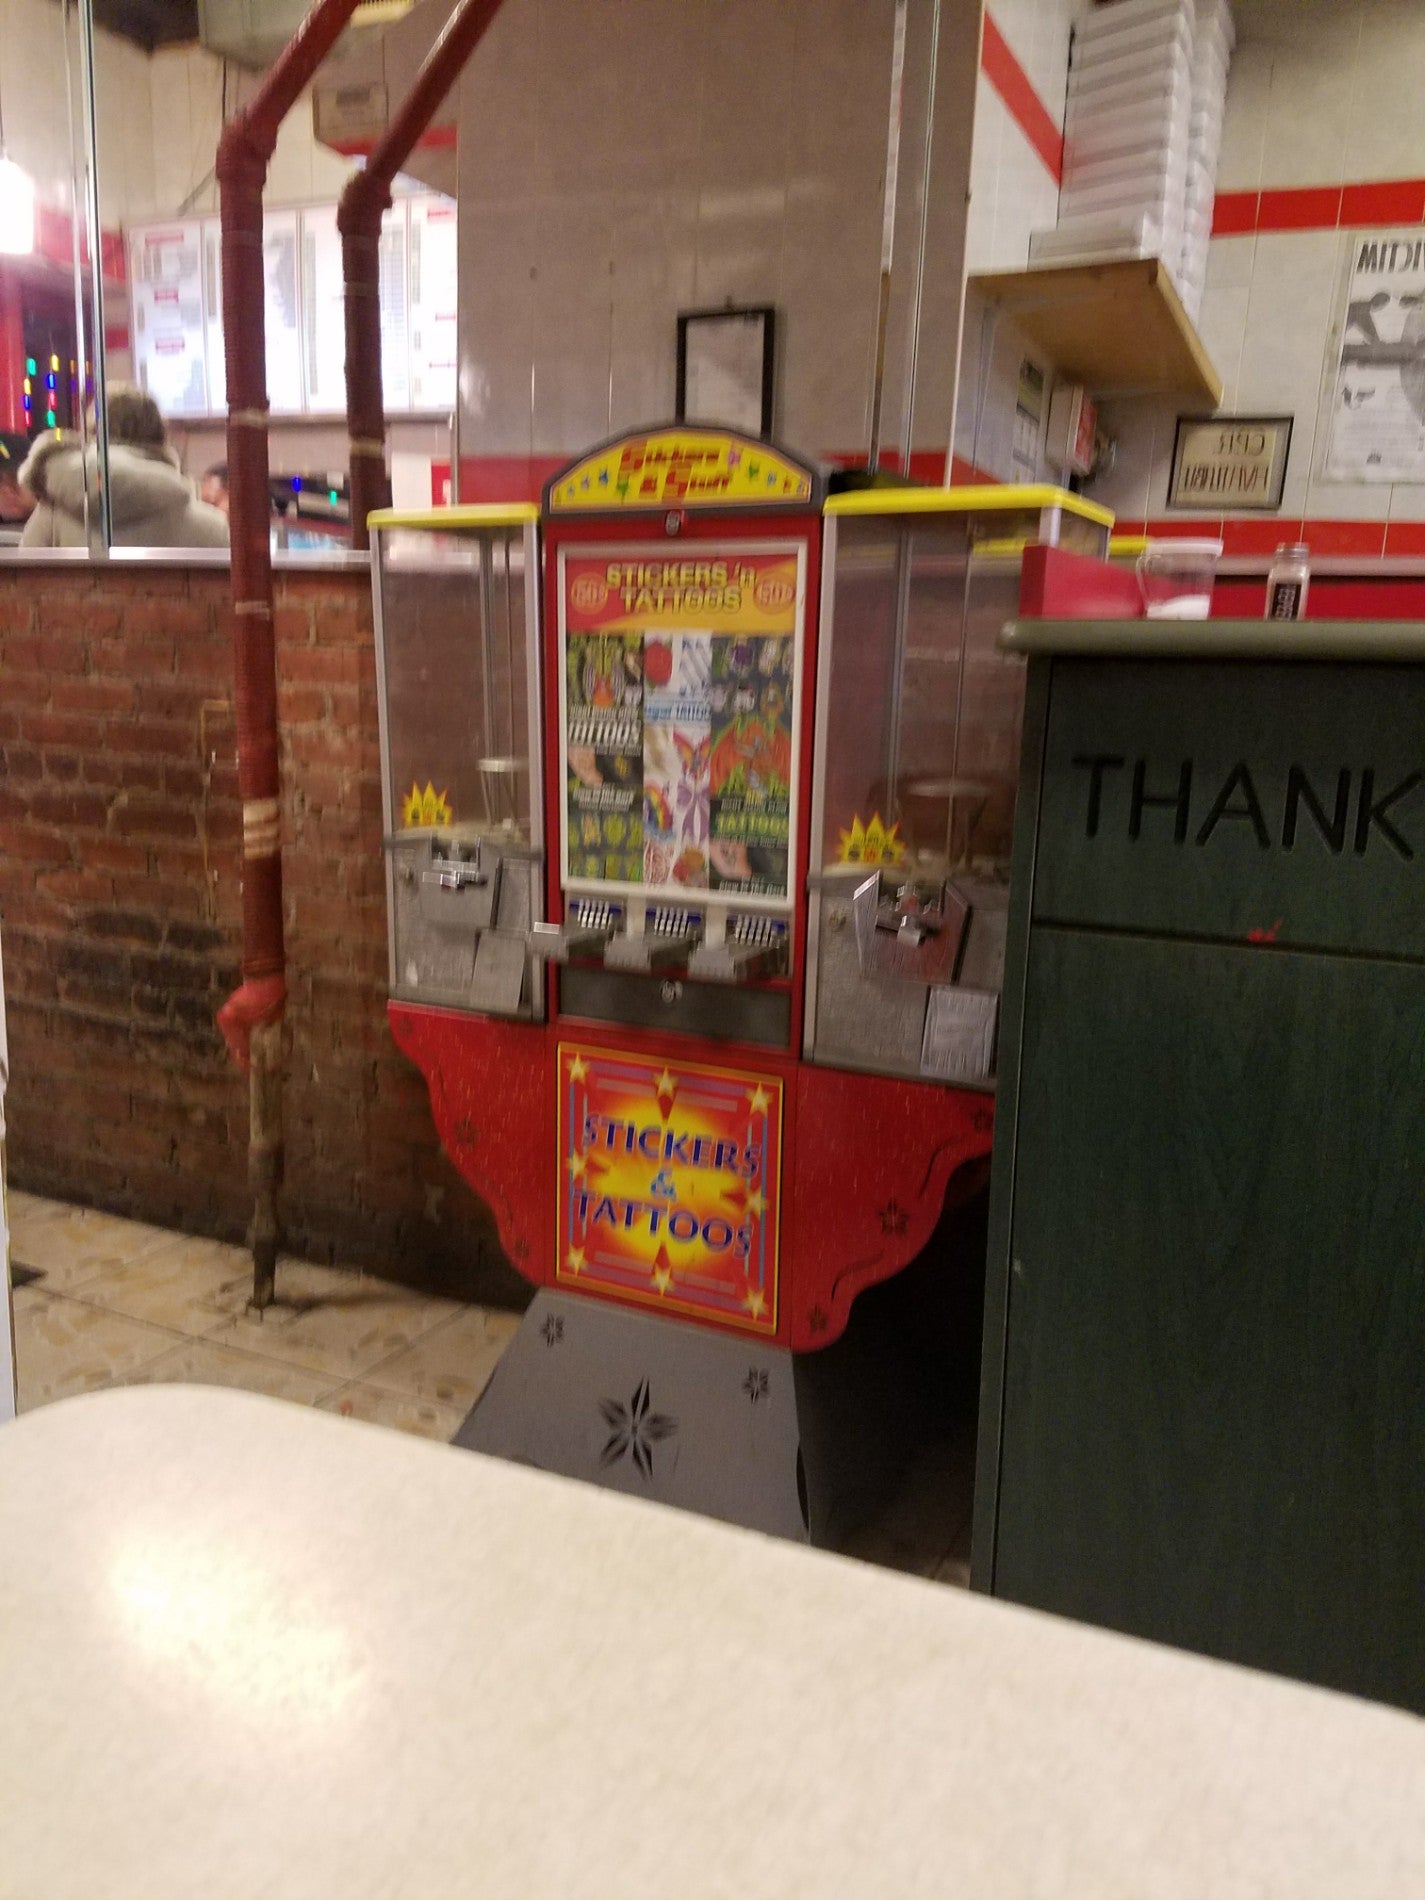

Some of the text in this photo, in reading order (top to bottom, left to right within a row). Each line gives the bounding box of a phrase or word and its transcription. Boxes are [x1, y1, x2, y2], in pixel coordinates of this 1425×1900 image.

[606, 561, 728, 589] STICKERS
[620, 585, 742, 614] TATTOOS
[1071, 754, 1425, 862] THANK
[584, 1112, 763, 1178] STICKERS
[650, 1165, 677, 1202] &
[572, 1187, 754, 1259] TATTOOS
